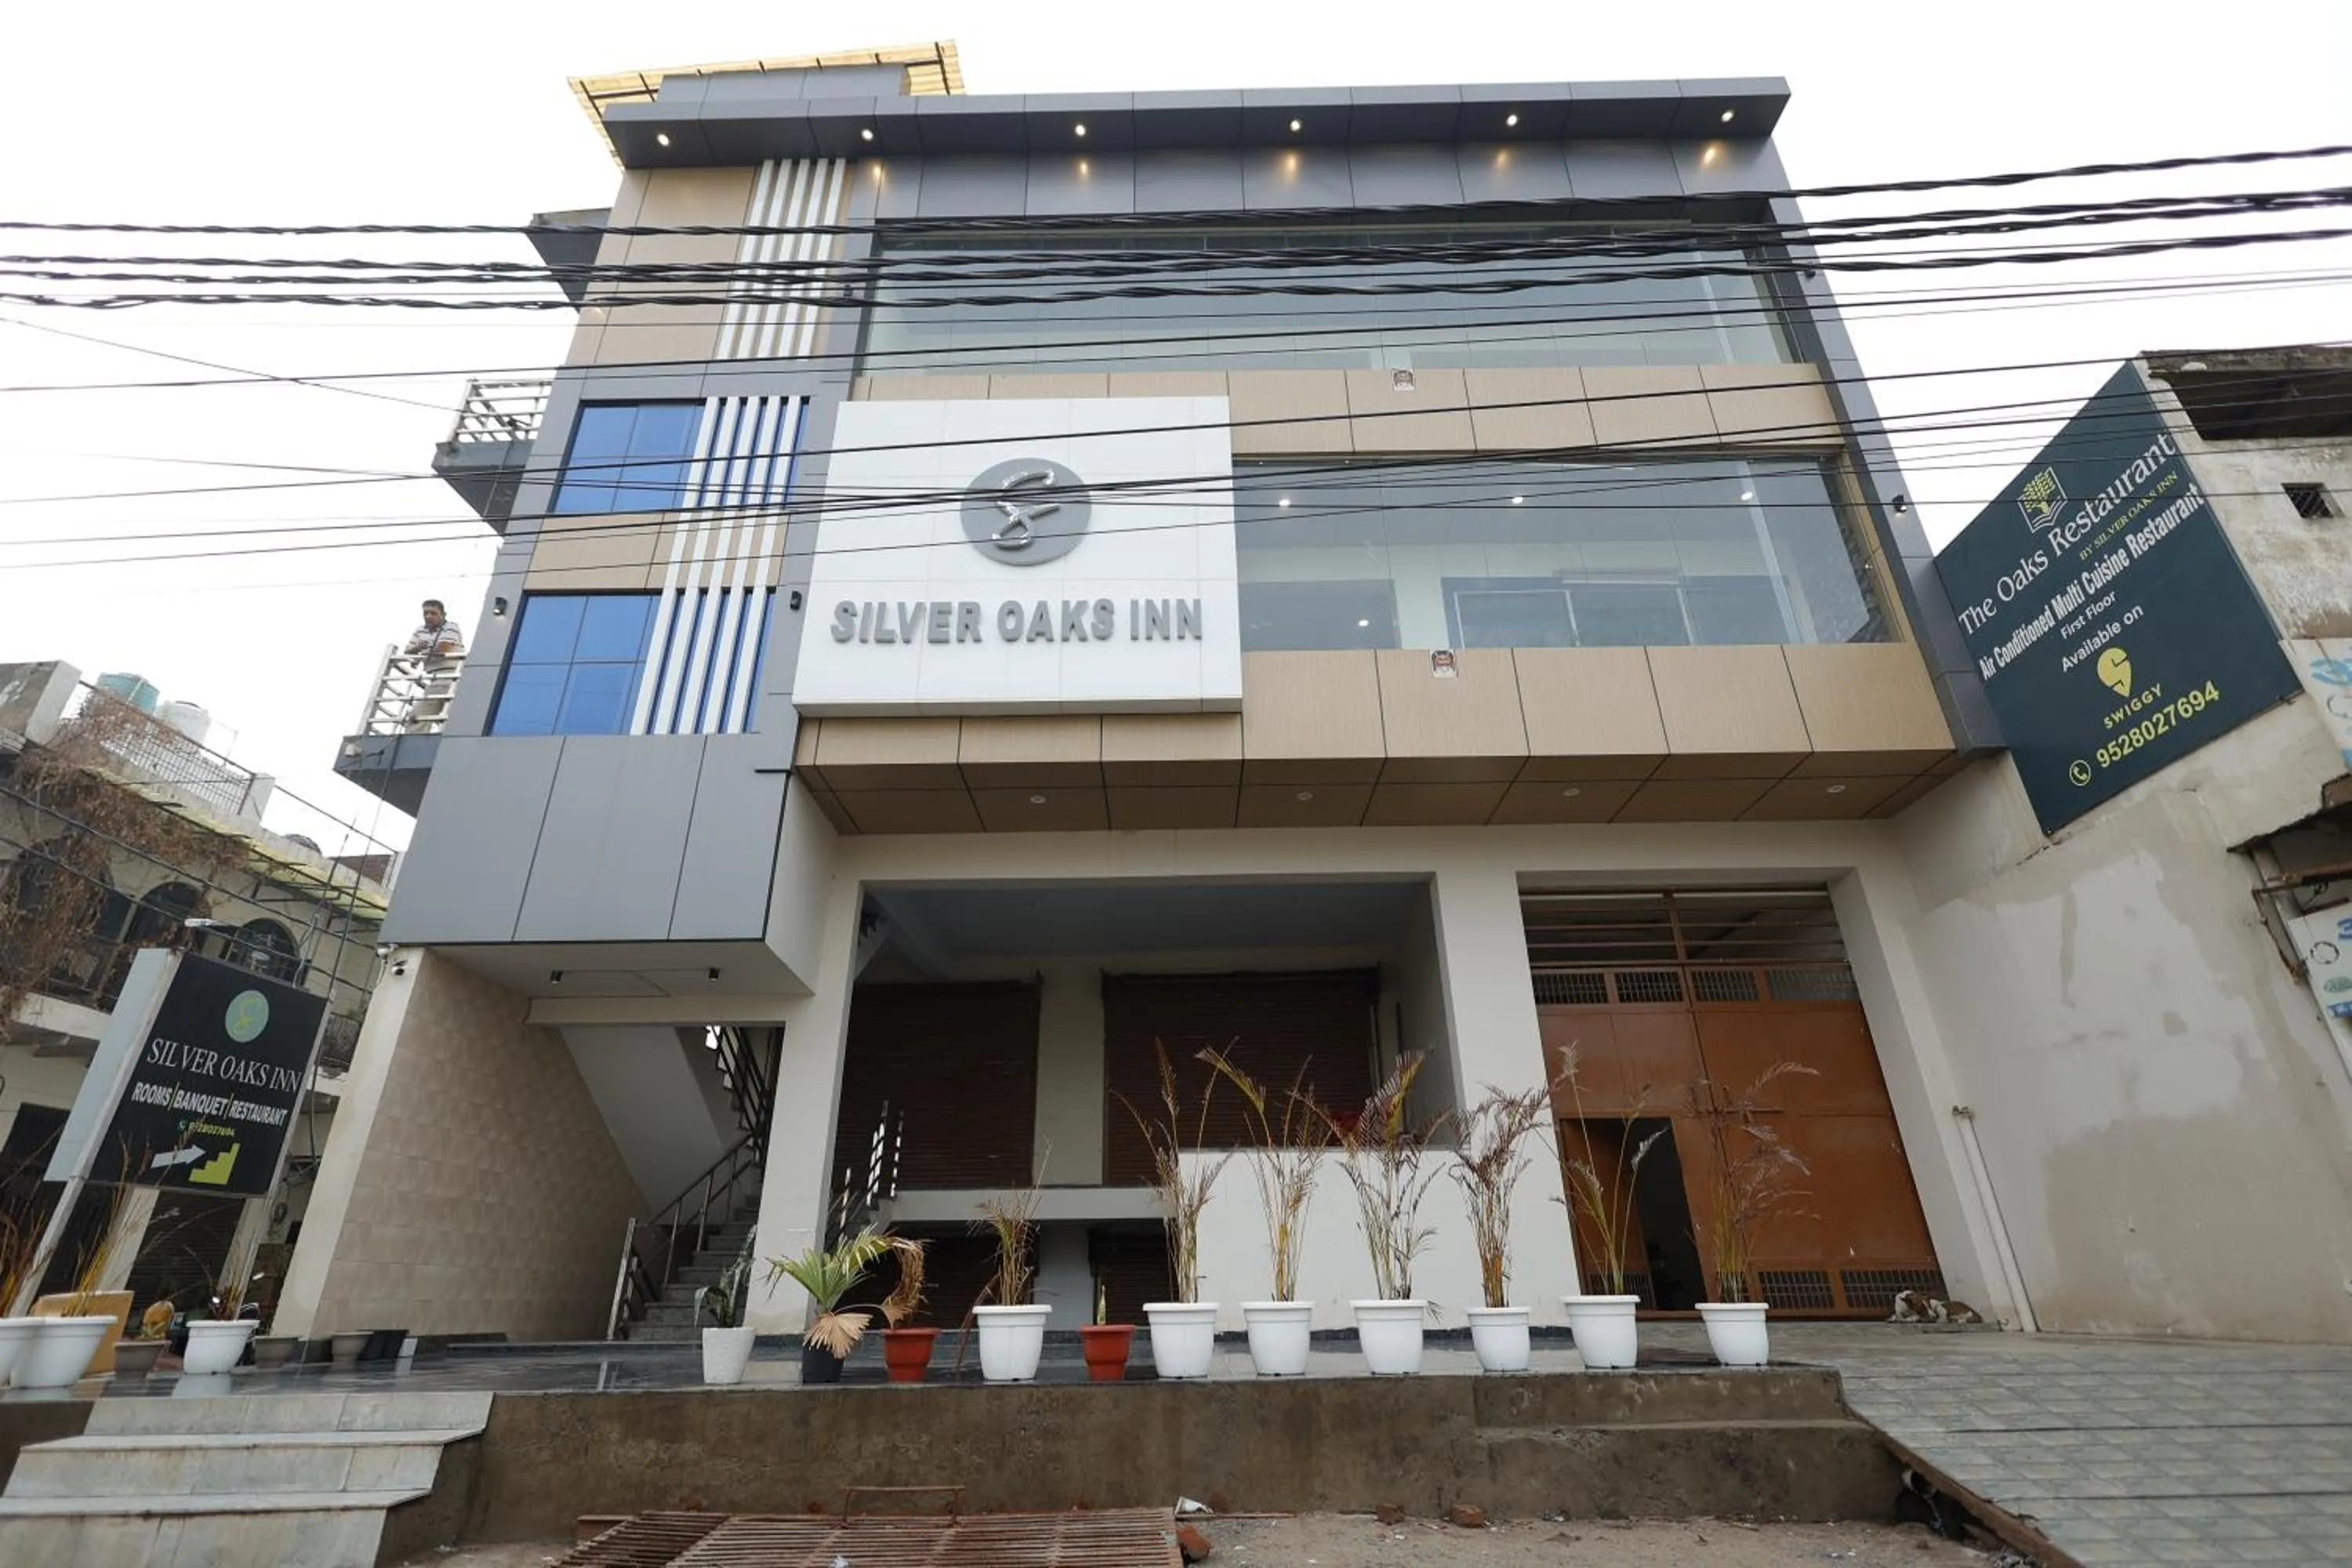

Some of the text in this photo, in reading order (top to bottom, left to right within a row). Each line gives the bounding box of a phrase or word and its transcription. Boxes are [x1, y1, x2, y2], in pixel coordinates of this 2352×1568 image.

[1958, 434, 2176, 634] The Oaks Restaurant
[2079, 470, 2178, 560] BY SILVER OAKS INN
[1979, 483, 2204, 681] Air Conditioned Multi Cuisine Restaurant
[2060, 591, 2117, 639] First Floor
[830, 598, 1203, 644] SILVER OAKS INN
[2062, 605, 2144, 673] Available on
[2096, 681, 2219, 768] 9528027694
[2103, 683, 2161, 728] SWIGGY
[147, 1038, 303, 1093] SILVER OAKS INN
